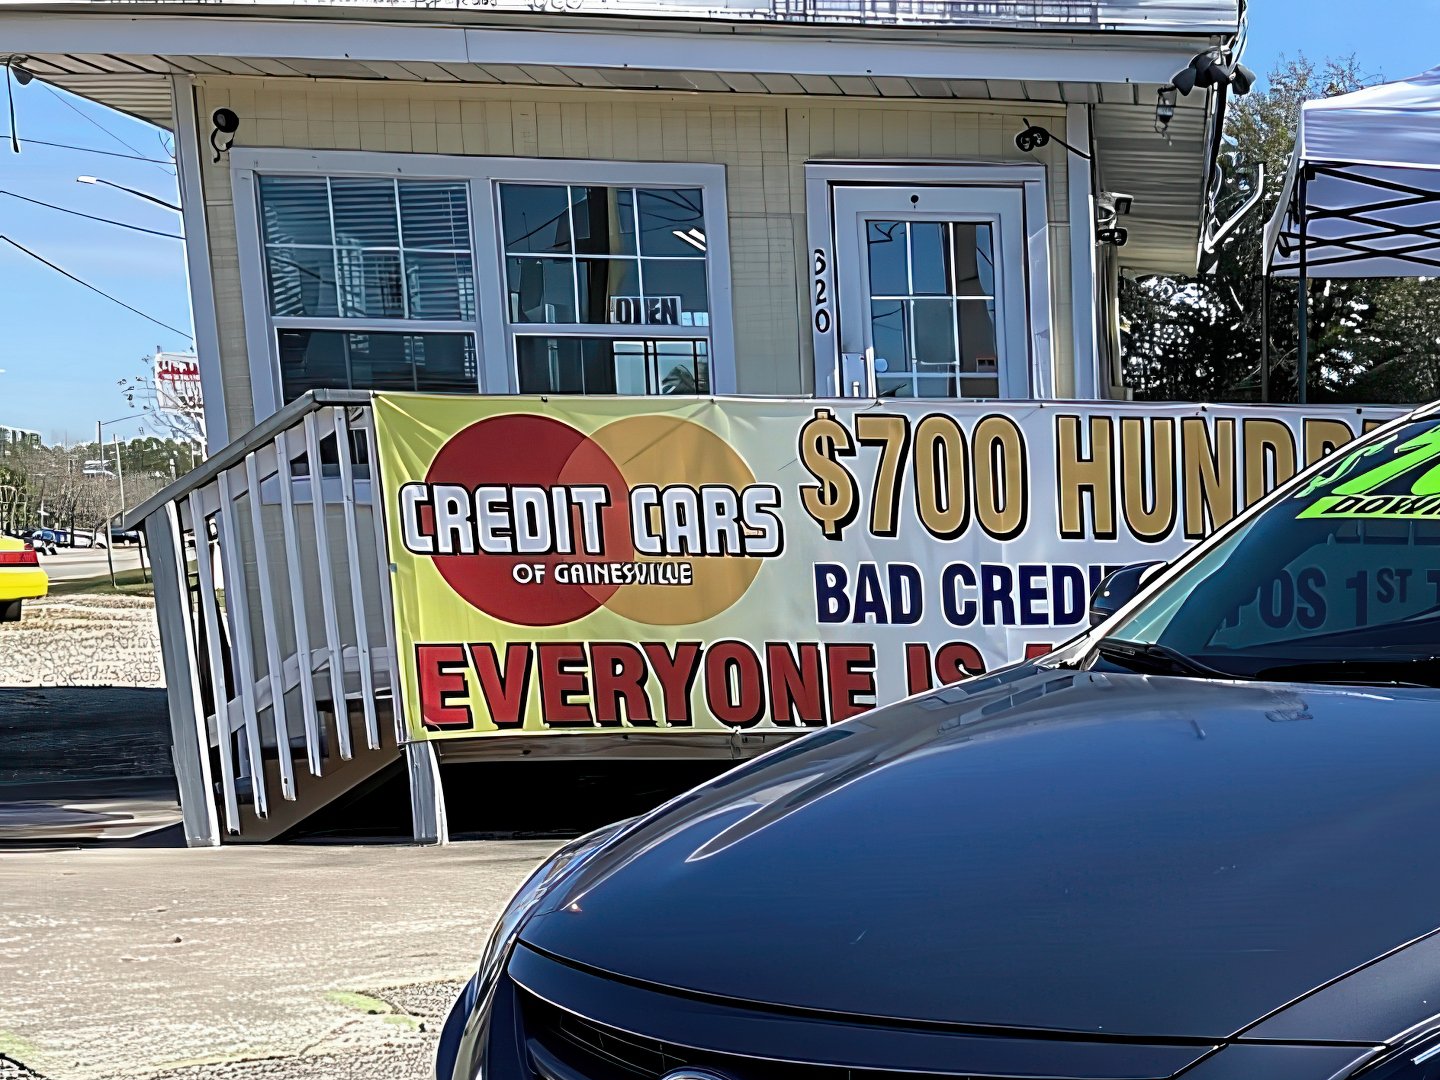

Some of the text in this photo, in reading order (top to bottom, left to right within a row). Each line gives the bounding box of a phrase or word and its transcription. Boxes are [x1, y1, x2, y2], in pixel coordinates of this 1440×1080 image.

[799, 408, 1026, 541] $700
[399, 483, 785, 558] CREDIT CARS
[512, 561, 693, 586] OF GAINESVILLE
[814, 563, 924, 627] BAD
[414, 640, 877, 729] EVERYONE
